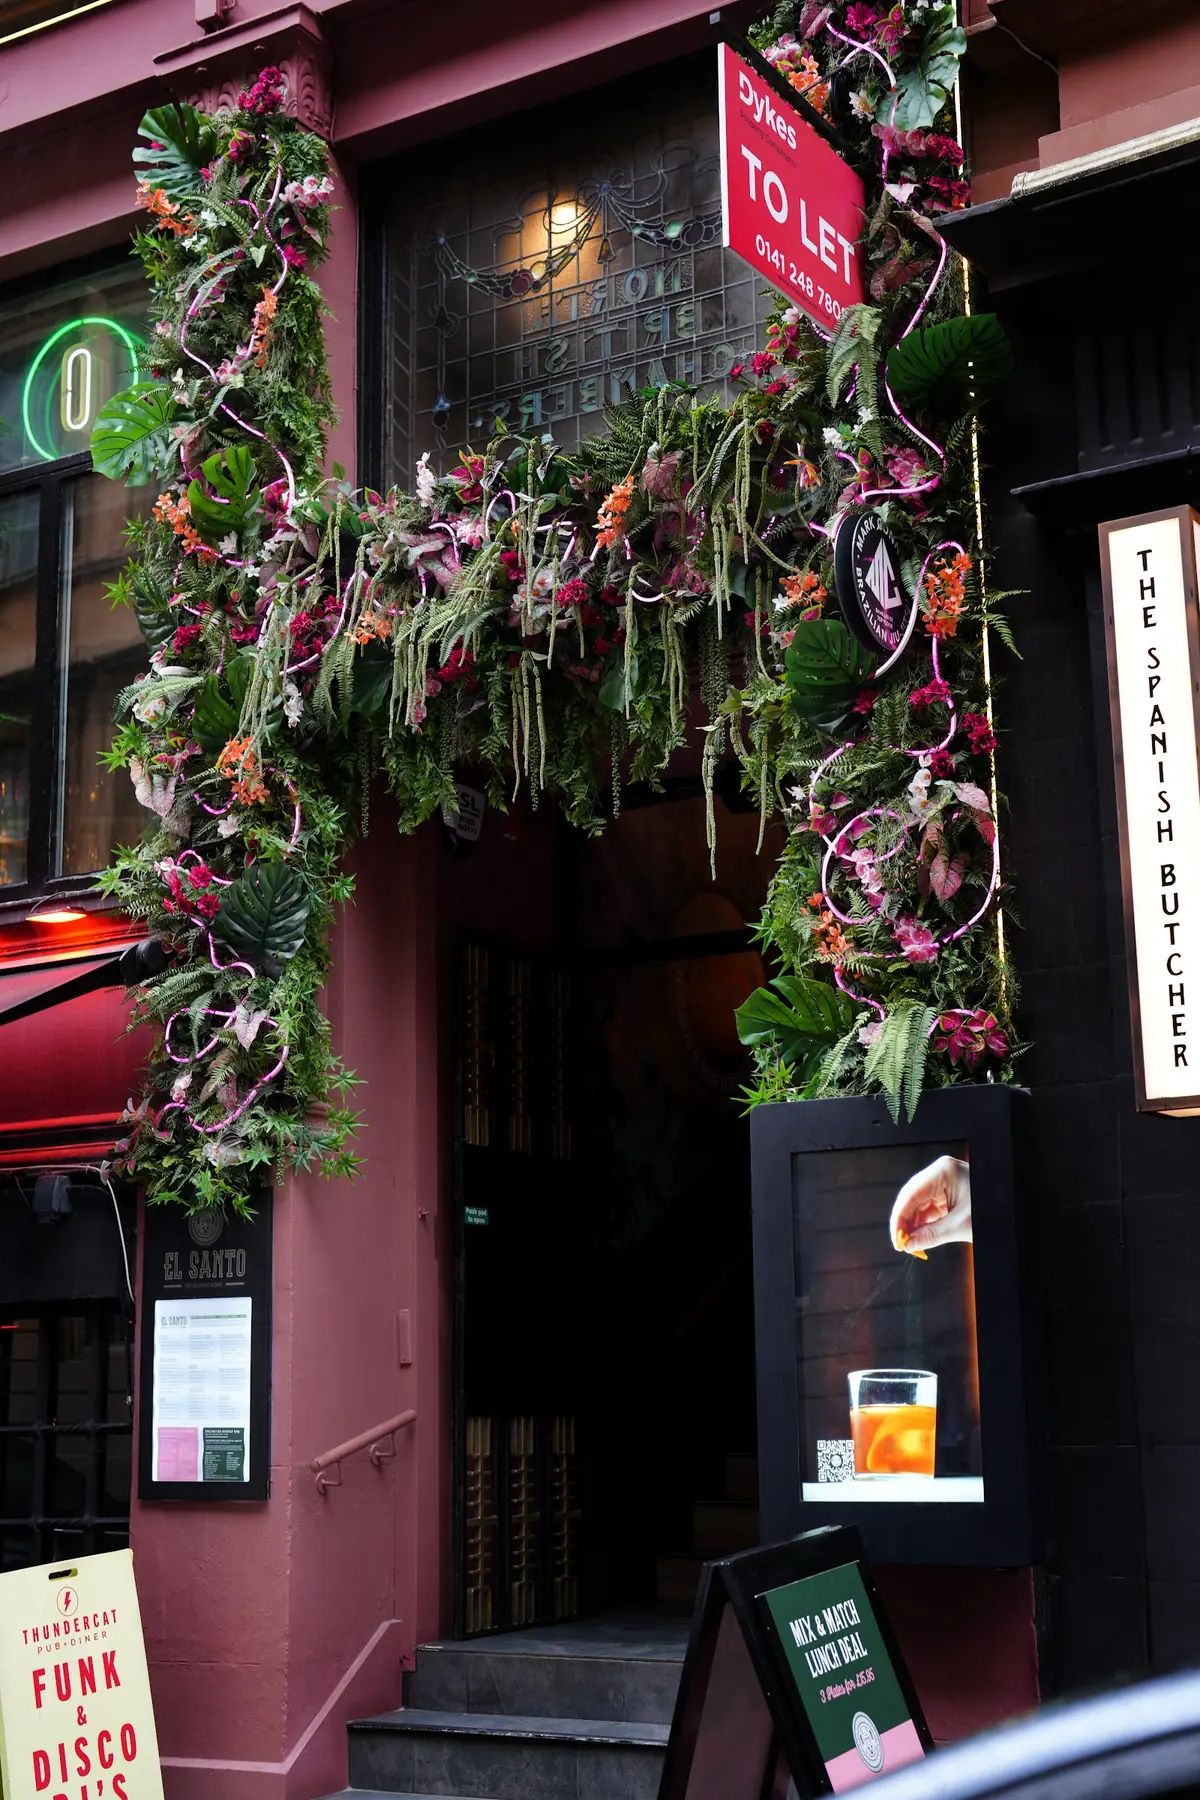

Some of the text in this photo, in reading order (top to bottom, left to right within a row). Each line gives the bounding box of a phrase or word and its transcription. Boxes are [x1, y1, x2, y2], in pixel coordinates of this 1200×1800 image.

[739, 70, 797, 150] Dykes
[741, 143, 855, 286] TO LET
[756, 234, 785, 275] 0141
[789, 262, 814, 298] 248
[856, 515, 876, 552] MARK
[855, 566, 887, 642] BRAZILIAN
[1136, 549, 1189, 1067] THE SPANISH BUTCHER
[465, 1206, 487, 1217] Push pad
[164, 1248, 246, 1280] EL SANTO
[22, 1609, 117, 1645] THUNDERCAT
[789, 1599, 861, 1648] MIX & MATCH
[804, 1632, 868, 1678] LUNCH DEAL
[32, 1650, 121, 1709] FUNK
[820, 1689, 826, 1703] 3
[826, 1684, 846, 1701] Plates
[844, 1678, 856, 1695] for
[76, 1705, 88, 1726] &
[32, 1723, 137, 1792] DISCO
[53, 1773, 128, 1800] 'S
